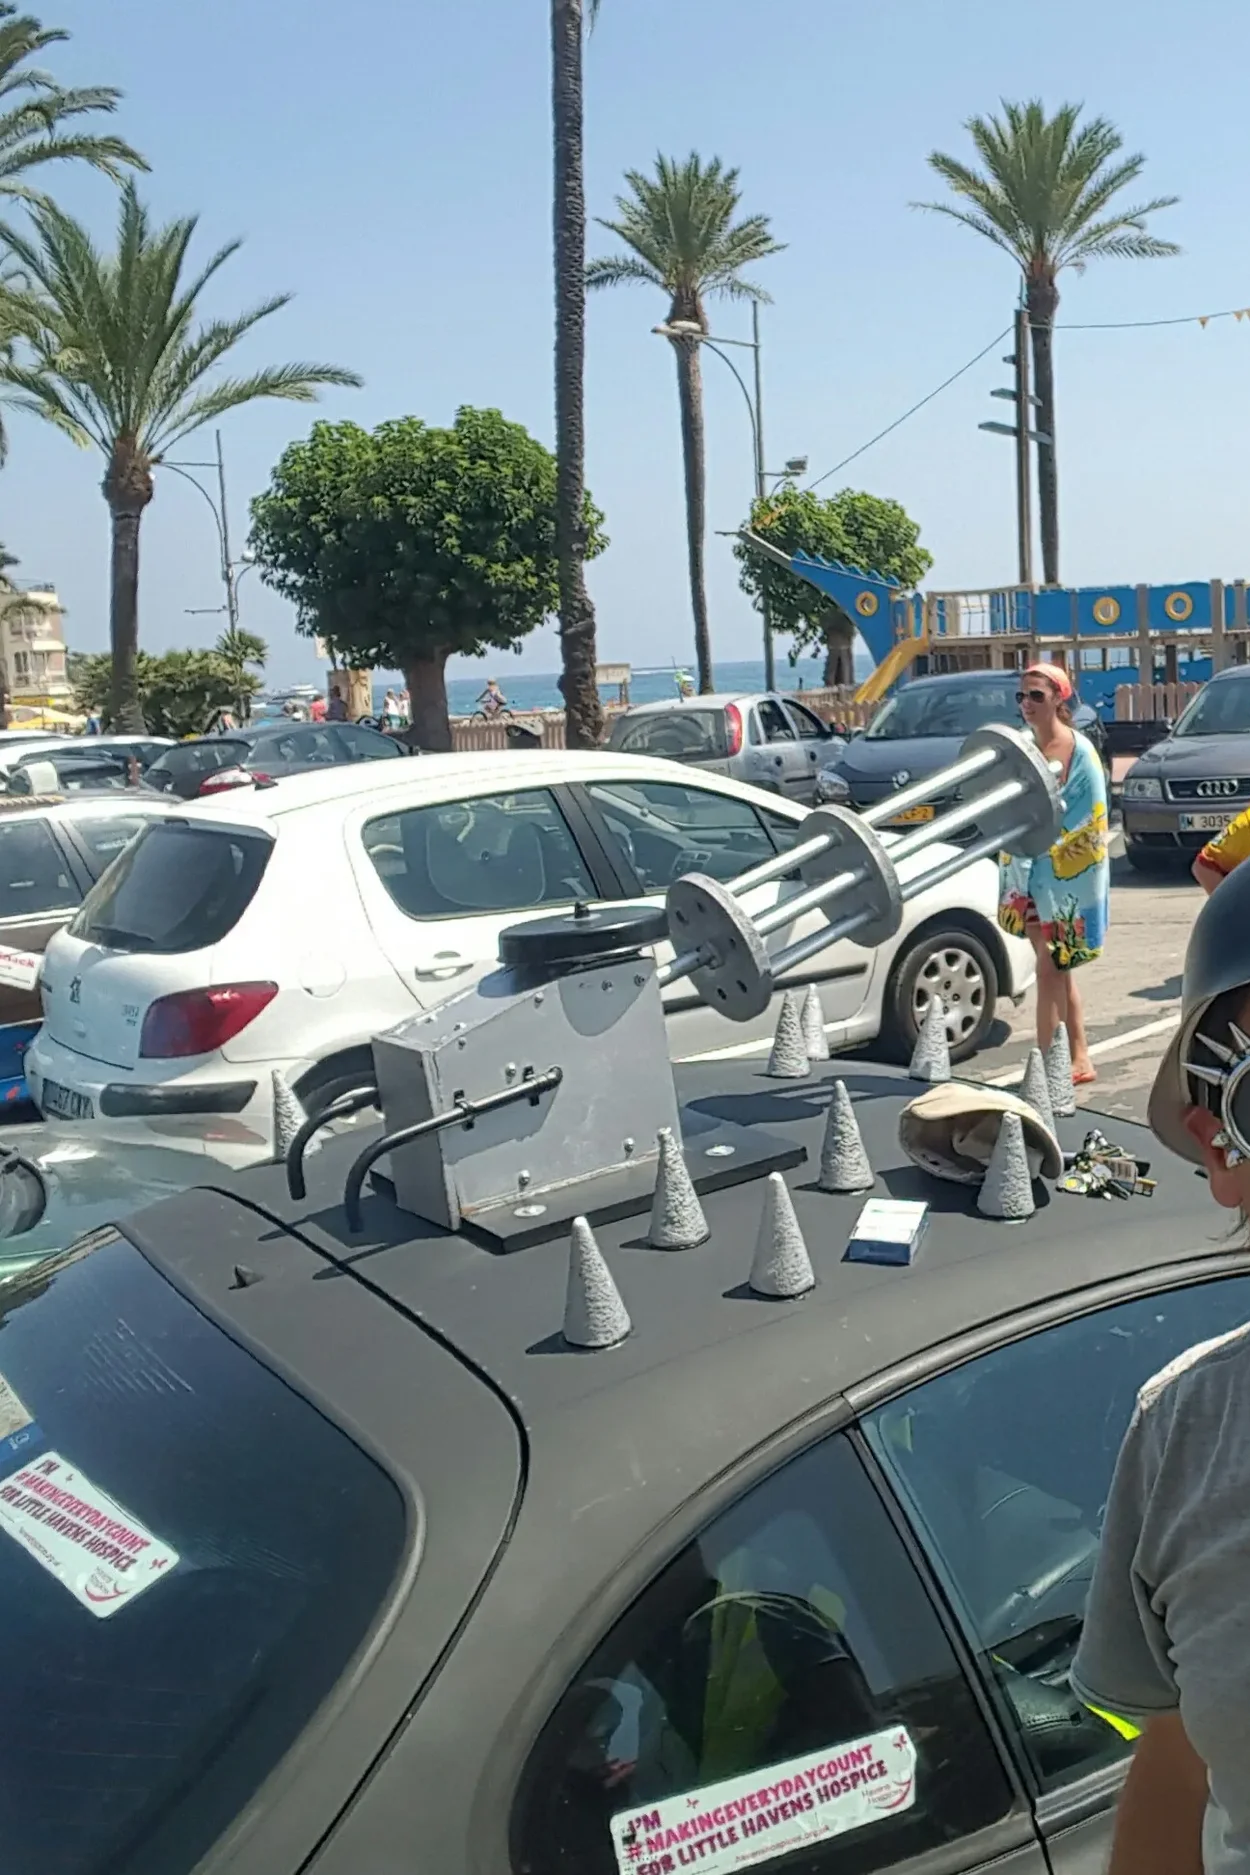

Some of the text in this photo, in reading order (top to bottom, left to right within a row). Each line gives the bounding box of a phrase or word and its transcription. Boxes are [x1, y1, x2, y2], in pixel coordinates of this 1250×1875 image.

[1202, 815, 1231, 828] 3035
[13, 1470, 152, 1554] #MAKINGEVERYDAYCOUNT
[41, 1511, 92, 1543] HAVENS
[81, 1535, 138, 1573] HOSPICE
[625, 1744, 873, 1862] #MAKINGEVERYDAYCOUNT
[677, 1825, 739, 1867] LITTLE
[741, 1792, 815, 1838] HAVENS
[816, 1759, 888, 1804] HOSPICE
